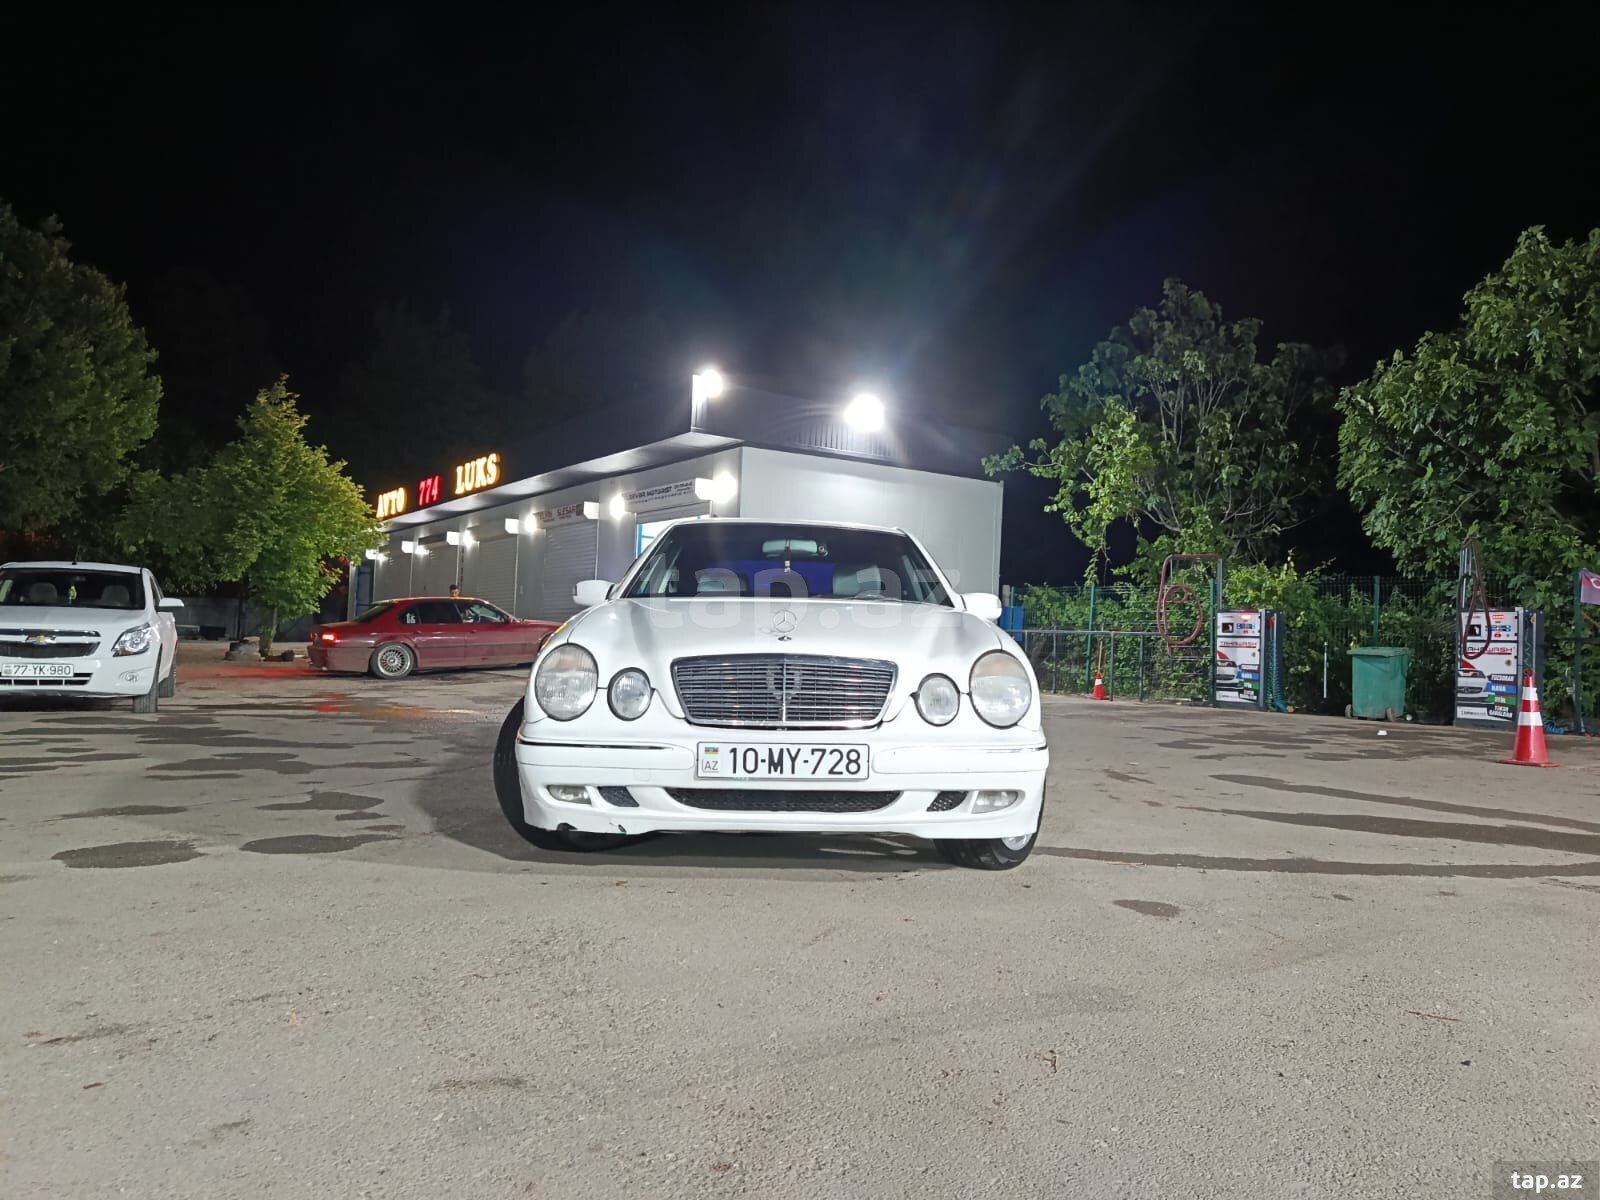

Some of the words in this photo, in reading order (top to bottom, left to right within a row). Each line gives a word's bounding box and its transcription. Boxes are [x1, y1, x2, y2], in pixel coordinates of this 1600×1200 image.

[375, 487, 406, 519] AVTO
[419, 475, 441, 506] 774
[704, 760, 719, 771] AZ
[729, 747, 862, 775] 10-MY-728
